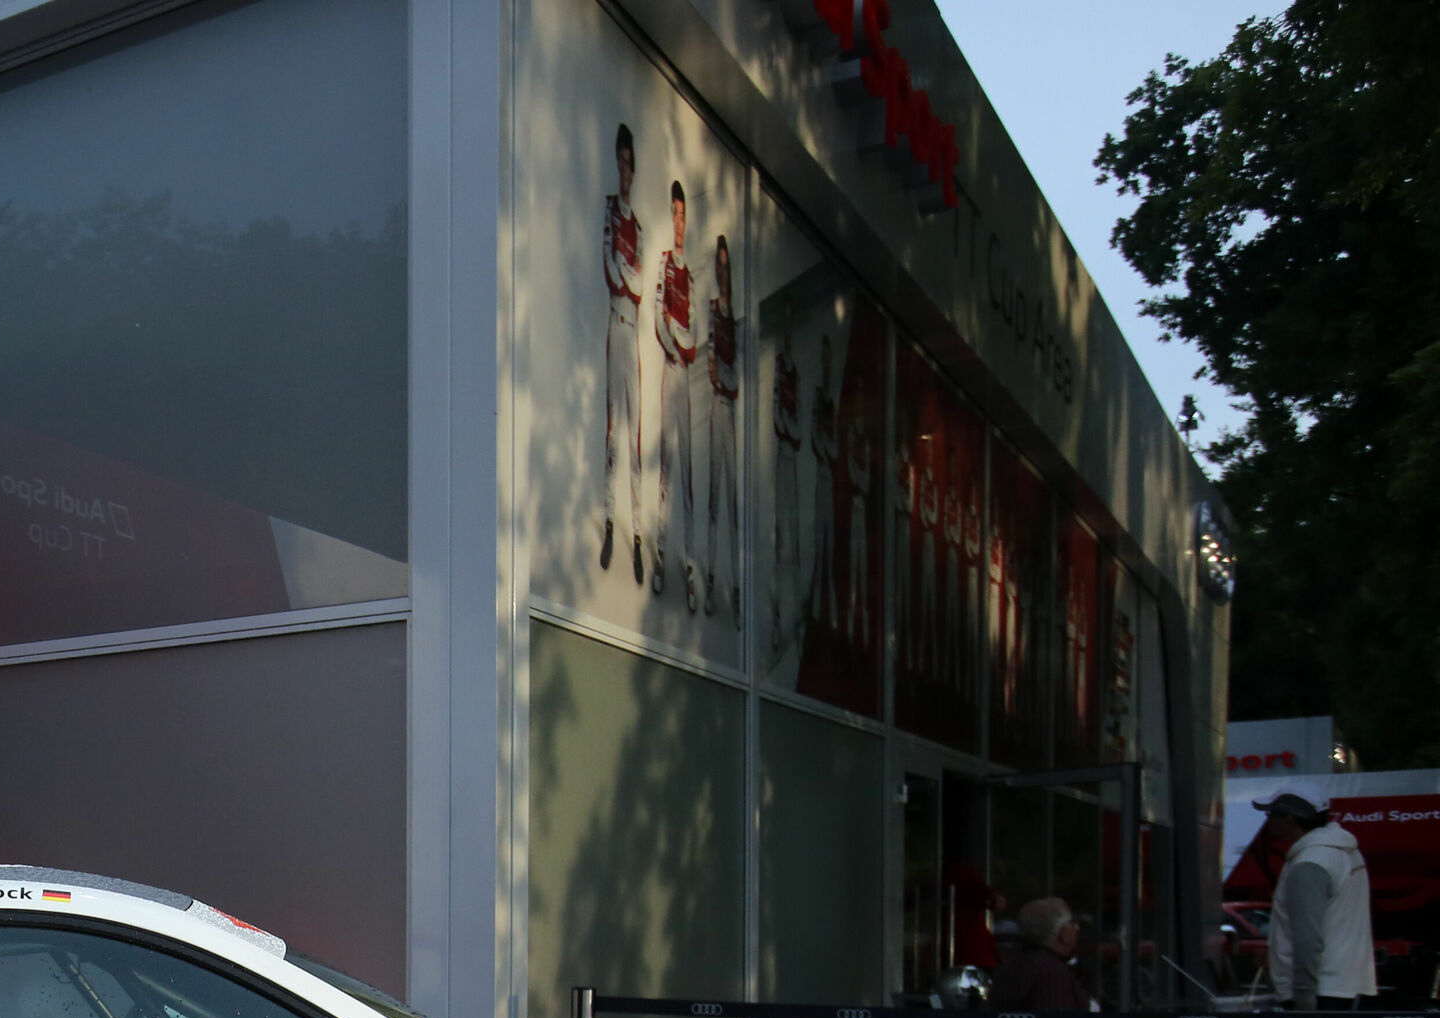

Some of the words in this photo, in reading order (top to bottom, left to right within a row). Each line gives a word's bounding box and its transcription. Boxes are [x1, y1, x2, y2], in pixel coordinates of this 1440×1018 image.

[1225, 750, 1297, 772] port
[1341, 811, 1384, 823] Audi
[1387, 809, 1440, 824] Sport
